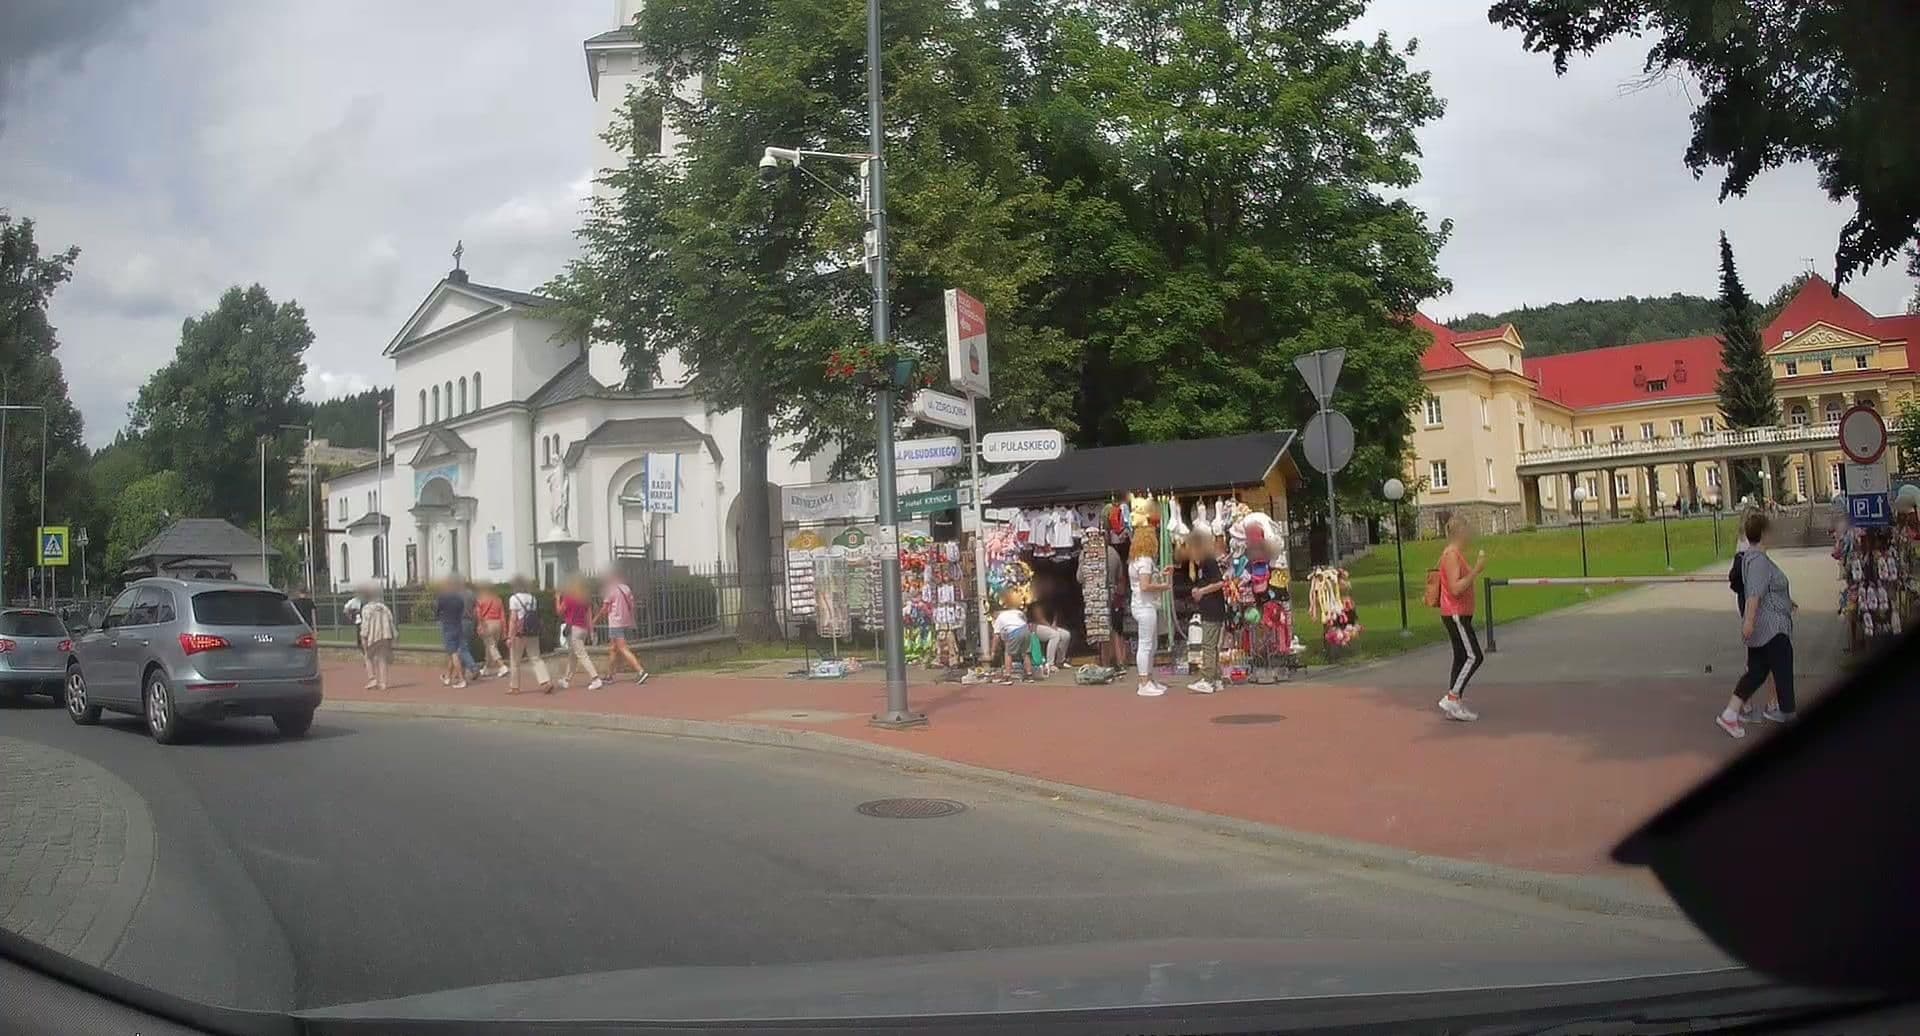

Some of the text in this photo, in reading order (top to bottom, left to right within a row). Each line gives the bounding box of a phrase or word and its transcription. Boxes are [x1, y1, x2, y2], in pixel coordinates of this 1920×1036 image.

[1001, 440, 1057, 452] PUŁASKIEGO
[651, 480, 672, 489] RADIO
[650, 490, 673, 500] MARYJA
[1857, 501, 1866, 515] P
